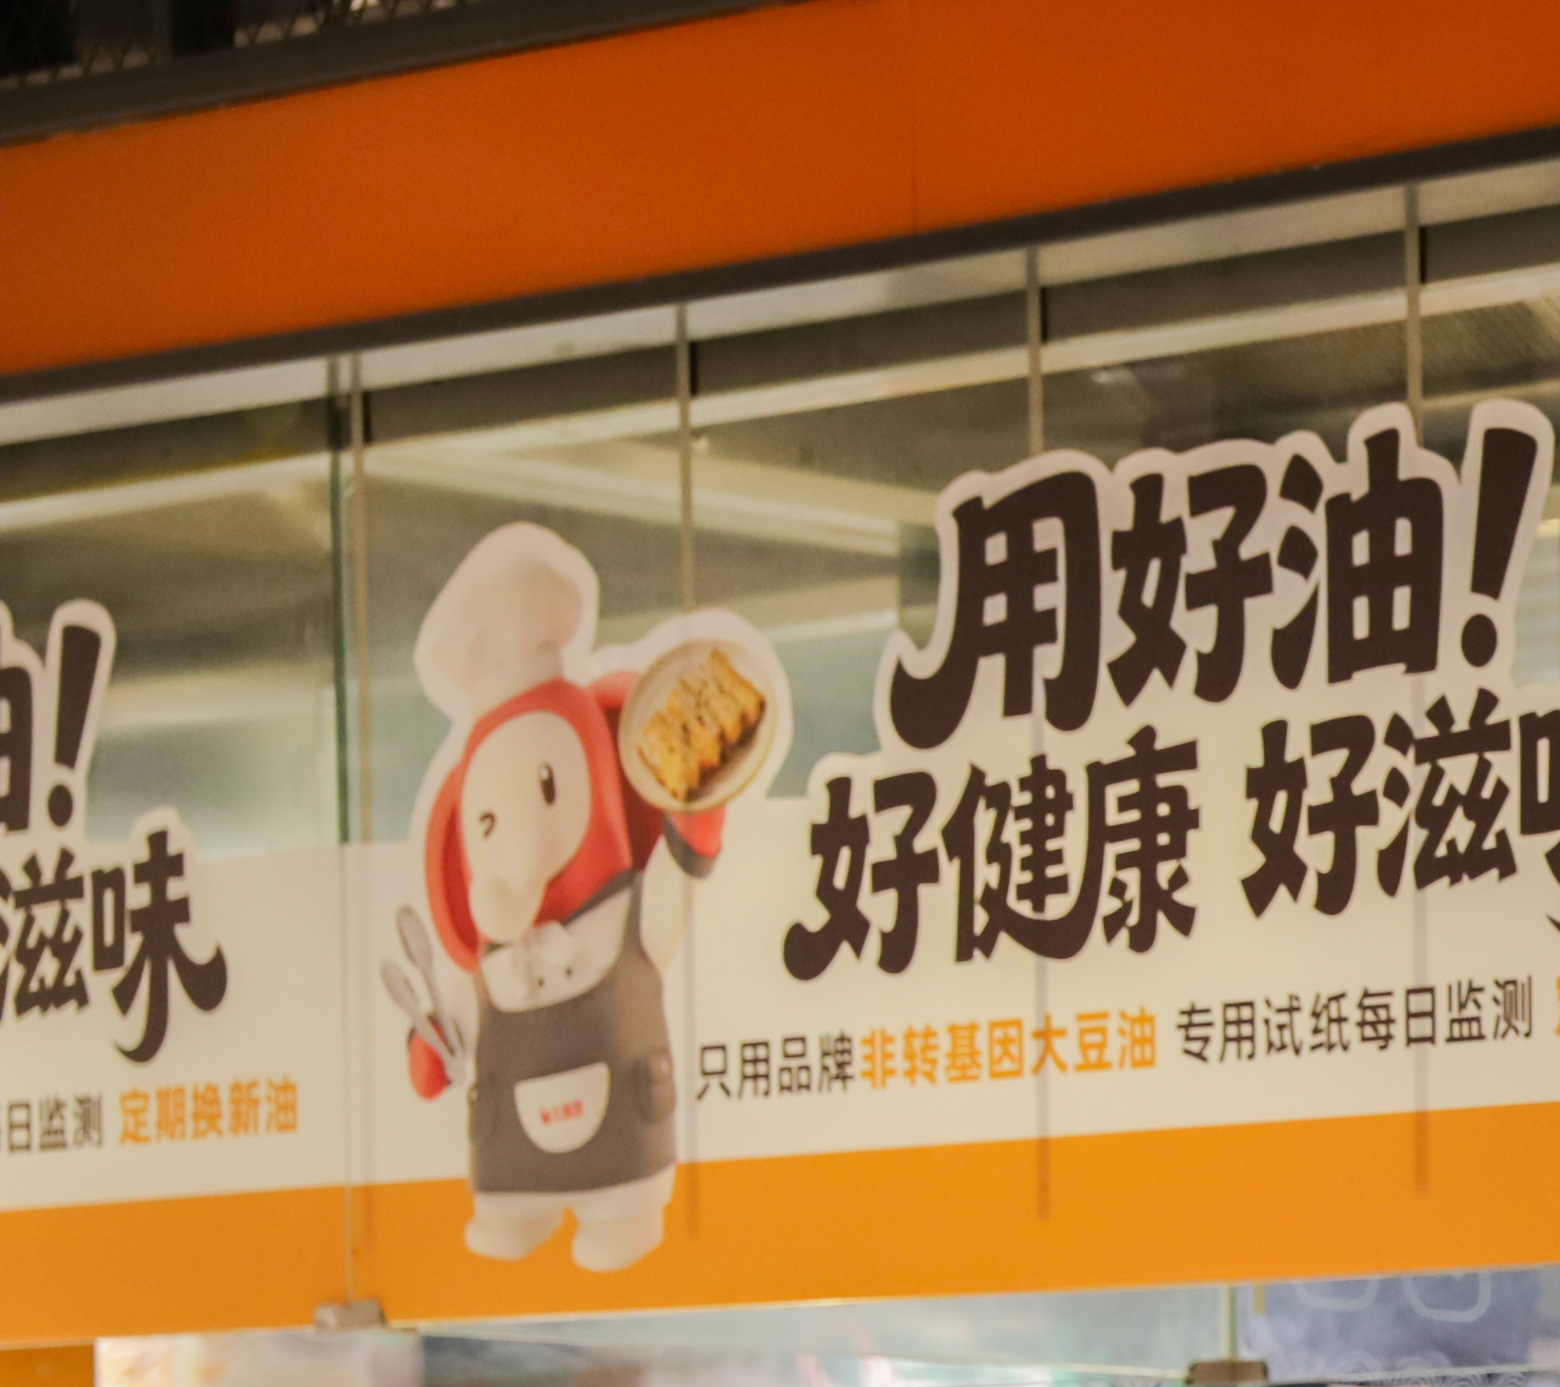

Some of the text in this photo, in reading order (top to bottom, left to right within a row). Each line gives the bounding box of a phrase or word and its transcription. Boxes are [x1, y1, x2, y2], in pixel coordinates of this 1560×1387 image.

[890, 427, 1537, 750] 用好油!
[782, 725, 1200, 981] 好健康
[0, 1075, 298, 1155] 日监测 定期换新油
[696, 1008, 1157, 1101] 只用品牌非转基因大豆油
[1176, 975, 1534, 1064] 专用试纸每日监测
